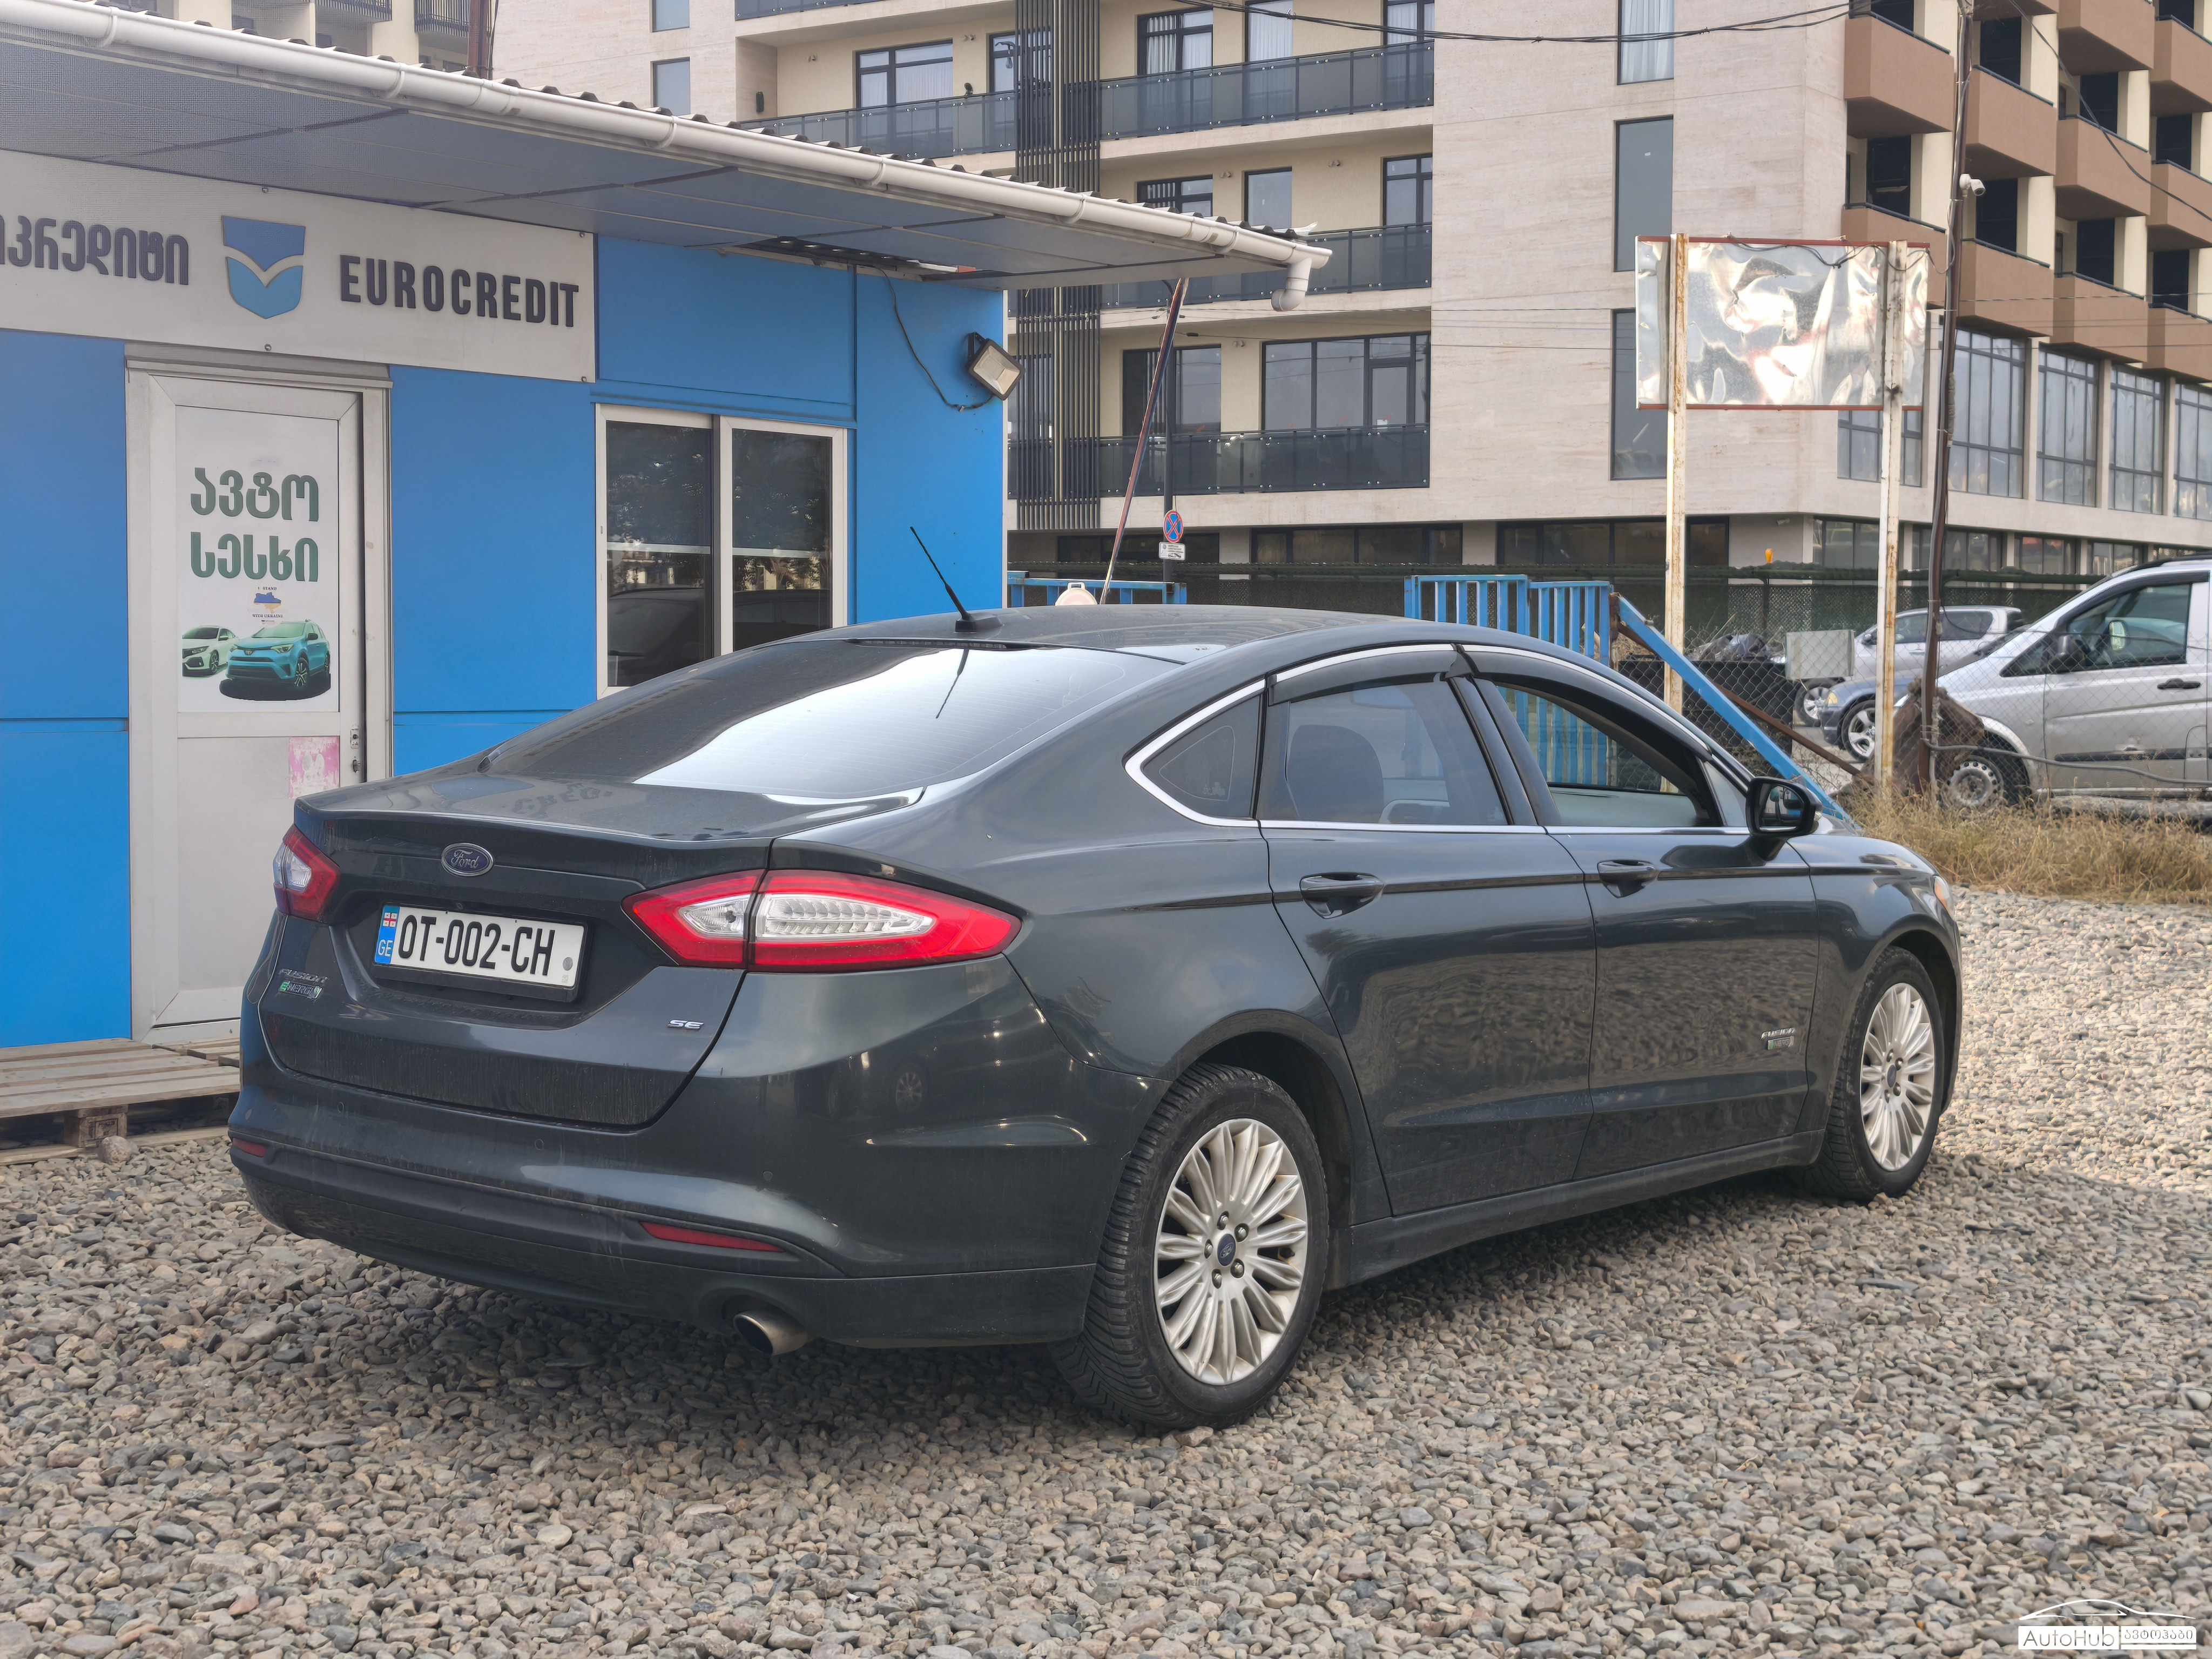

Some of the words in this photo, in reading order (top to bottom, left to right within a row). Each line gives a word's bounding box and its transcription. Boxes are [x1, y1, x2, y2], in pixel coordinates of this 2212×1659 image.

[0, 214, 189, 286] კრედიტი
[340, 254, 579, 328] EUROCREDIT
[190, 467, 319, 522] ავტო
[190, 531, 319, 582] სესხი
[450, 849, 480, 869] Ford
[377, 939, 394, 957] GE
[398, 914, 556, 976] OT-002-CH
[667, 1019, 705, 1030] SE
